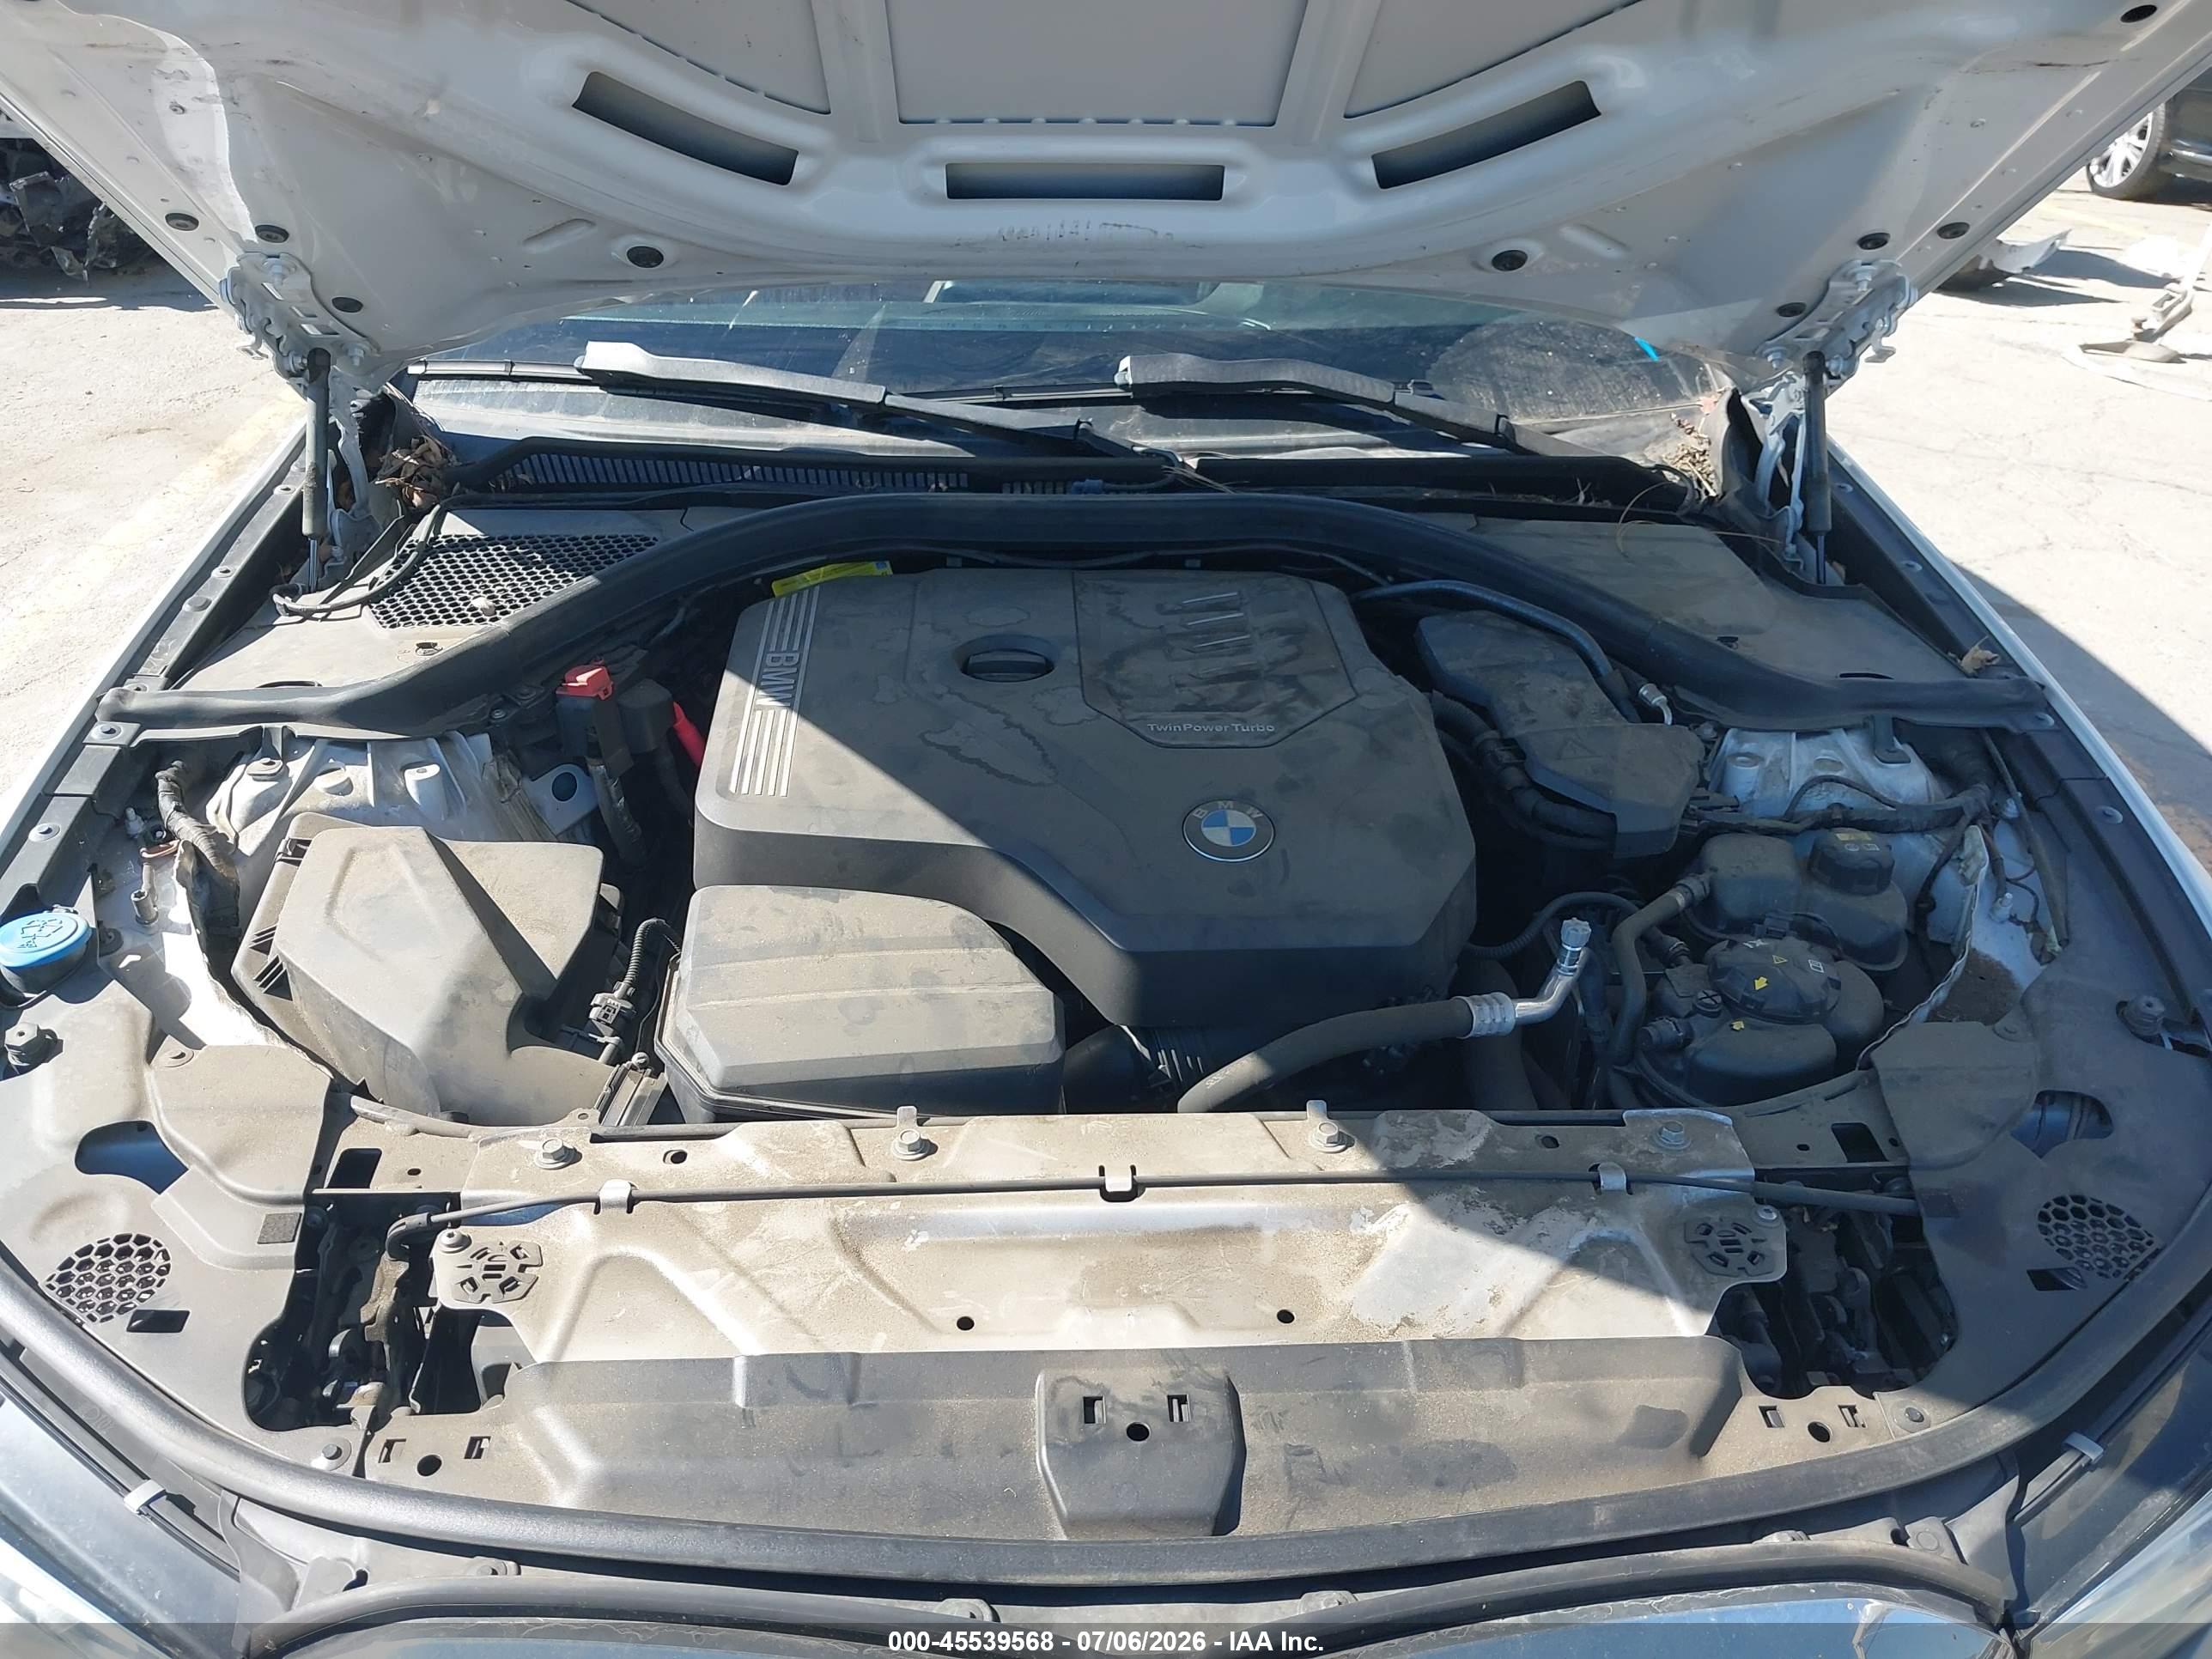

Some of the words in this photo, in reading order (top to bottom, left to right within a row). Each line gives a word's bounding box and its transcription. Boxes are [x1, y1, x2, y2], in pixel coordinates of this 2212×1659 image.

[756, 653, 799, 706] BMW
[1146, 723, 1230, 732] TwinPower
[1231, 723, 1275, 732] Turbo
[1193, 801, 1263, 818] BMW
